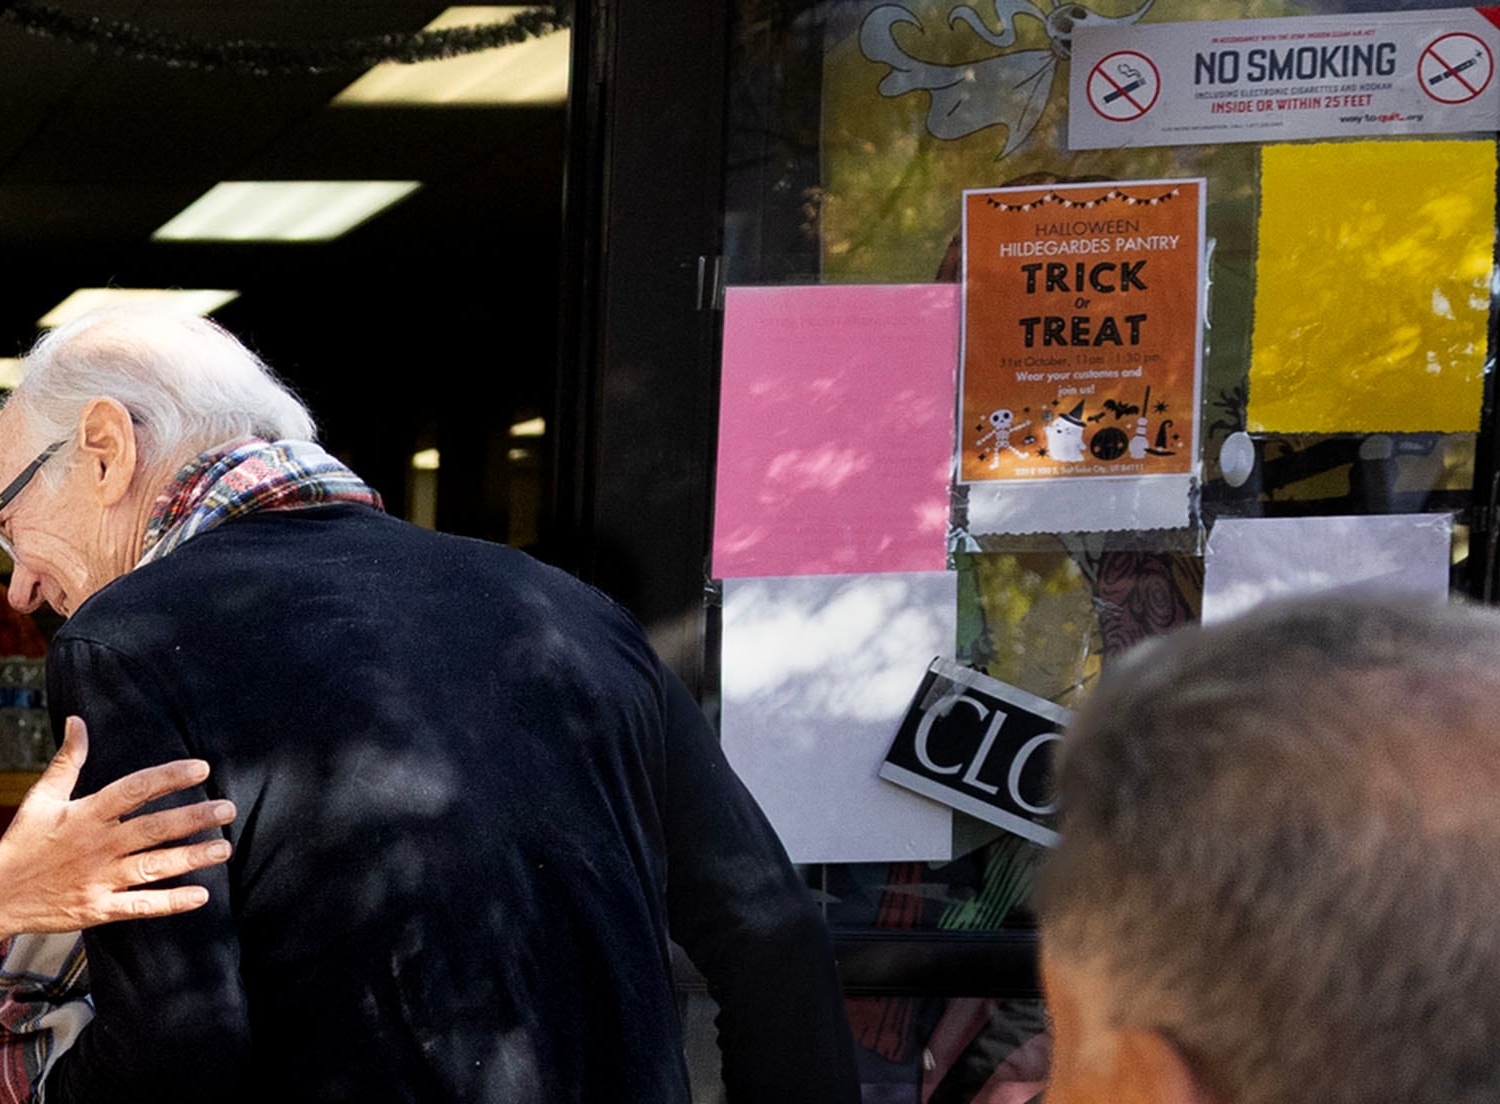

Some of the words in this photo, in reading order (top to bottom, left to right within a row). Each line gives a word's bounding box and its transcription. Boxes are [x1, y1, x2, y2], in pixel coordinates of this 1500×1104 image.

[1194, 50, 1240, 84] NO
[1247, 42, 1396, 82] SMOKING
[1194, 91, 1239, 100] INCLUDING
[1240, 88, 1288, 98] ELECTRONIC
[1290, 84, 1338, 96] CIGARETTES
[1340, 84, 1356, 92] AND
[1359, 82, 1392, 92] HOOKAH
[1211, 100, 1253, 114] INSIDE
[1256, 98, 1274, 112] OR
[1277, 96, 1322, 111] WITHIN
[1325, 96, 1341, 108] 25
[1343, 94, 1373, 107] FEET
[1035, 220, 1140, 236] HALLOWEEN
[1000, 238, 1110, 257] HILDEGARDES
[1116, 235, 1180, 251] PANTRY
[1021, 260, 1148, 294] TRICK
[1019, 314, 1148, 348] TREAT
[1015, 372, 1044, 382] Wear
[1047, 372, 1071, 383] your
[1121, 366, 1142, 377] and
[1058, 385, 1077, 397] join
[1079, 384, 1096, 394] us!
